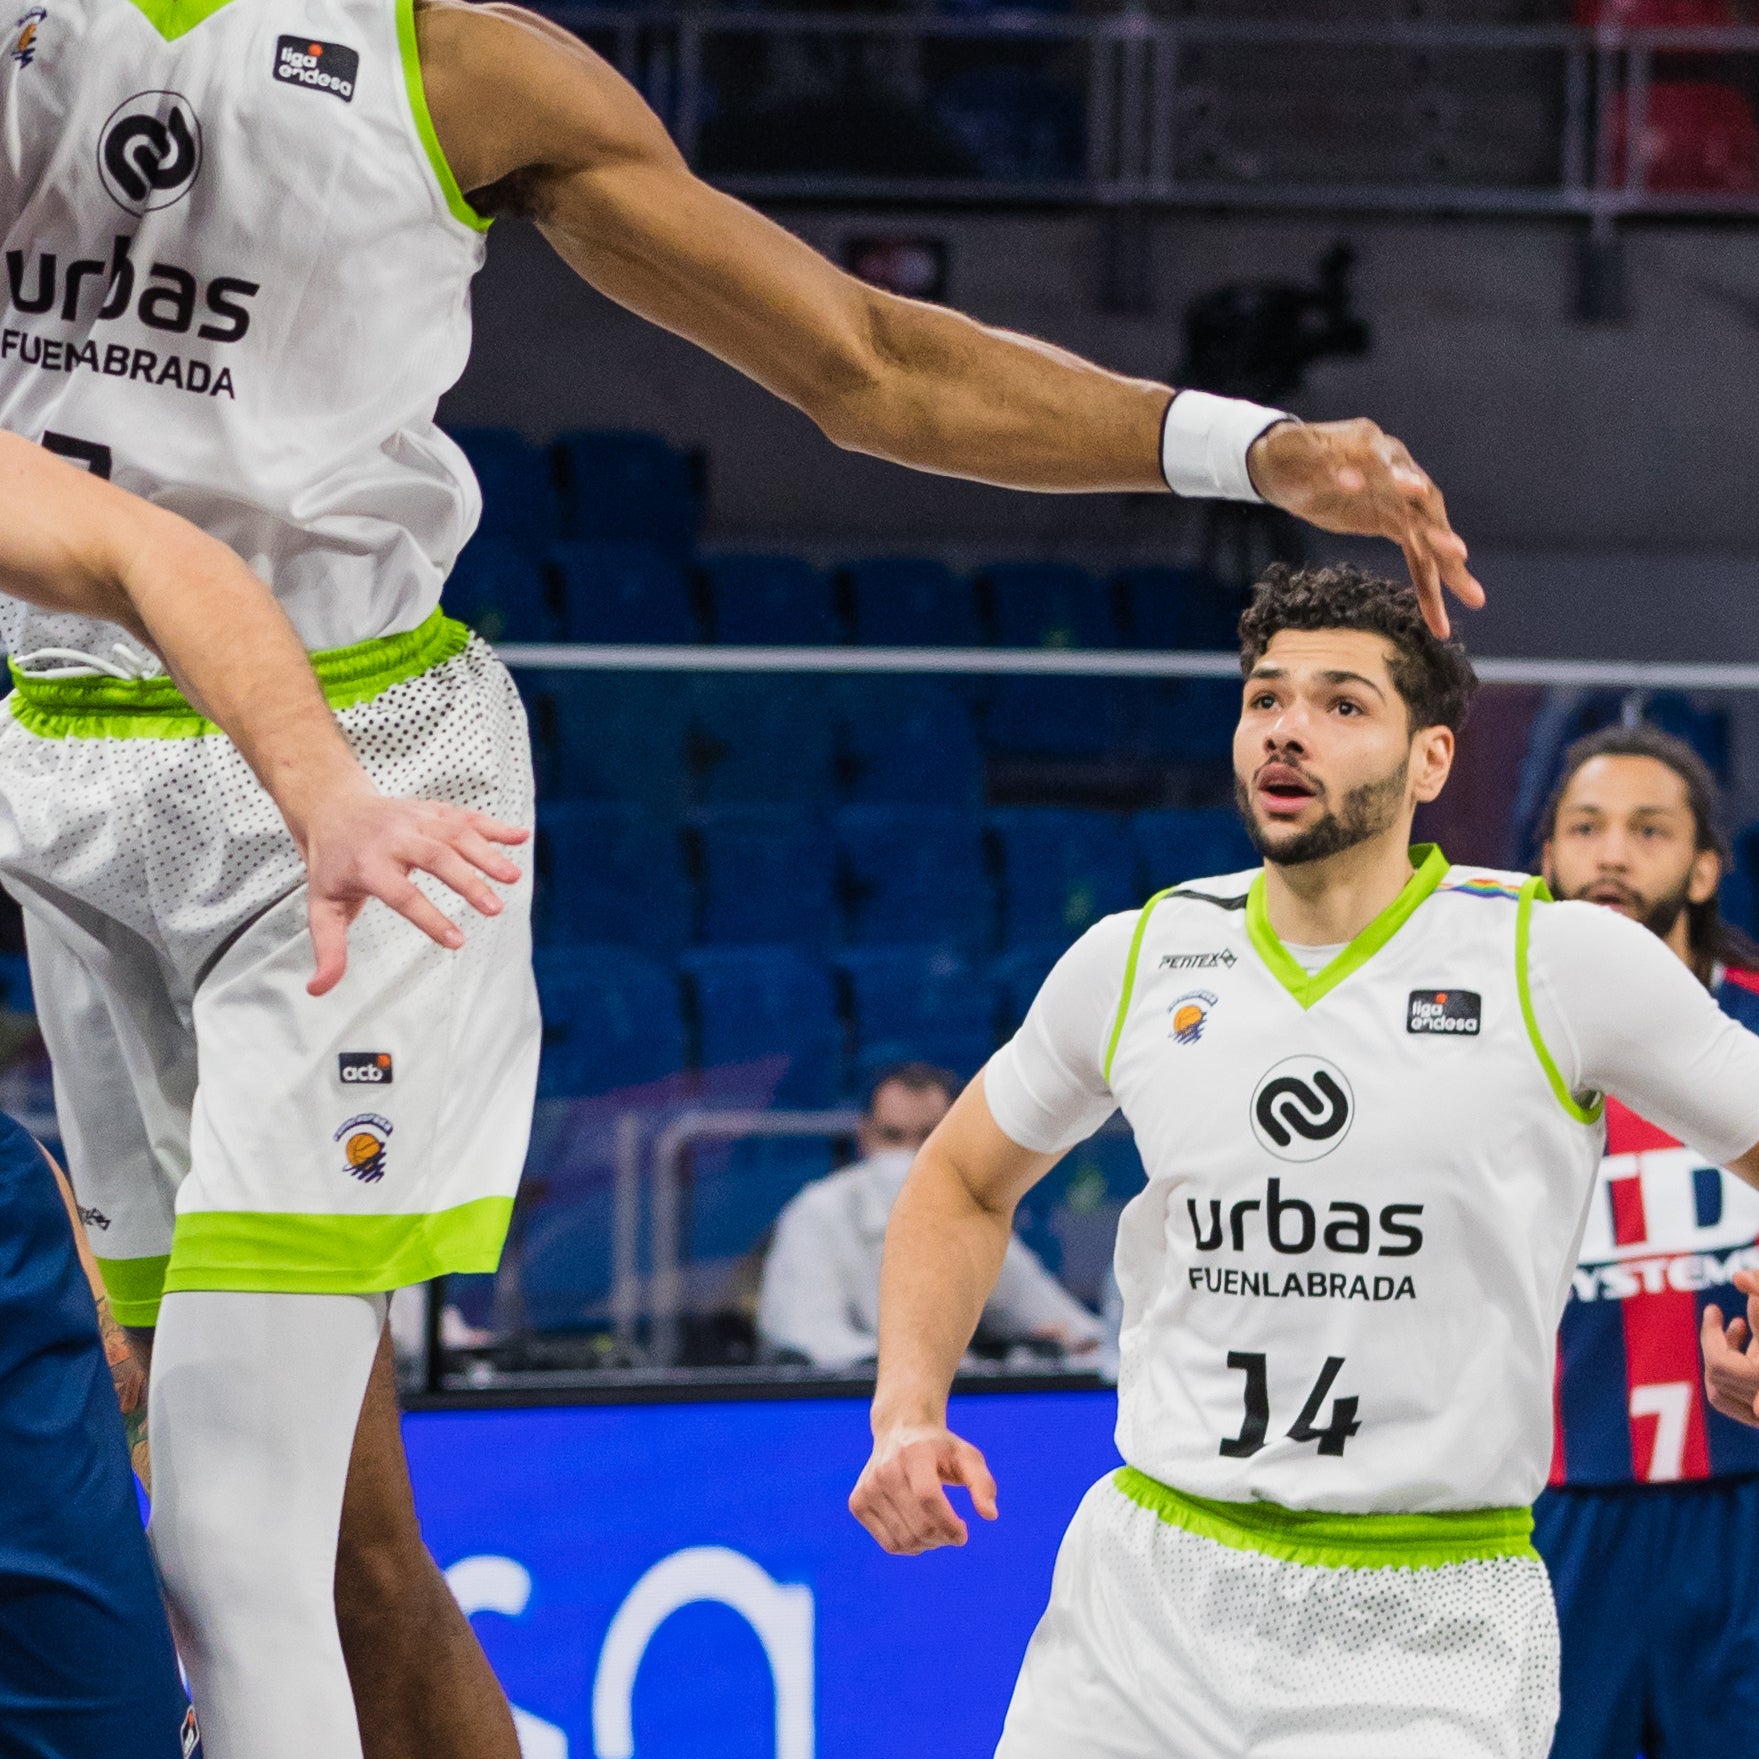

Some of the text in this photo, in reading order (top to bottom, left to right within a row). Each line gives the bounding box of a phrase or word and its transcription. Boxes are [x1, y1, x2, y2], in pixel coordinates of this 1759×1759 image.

[280, 46, 318, 69] liga
[278, 64, 352, 97] endesa
[6, 235, 261, 343] urbas
[1, 328, 236, 400] FUENABRADA
[1410, 1014, 1478, 1033] endesa
[1411, 999, 1444, 1018] liga
[342, 1063, 384, 1082] acb
[1186, 1177, 1425, 1257] urbas
[1188, 1267, 1417, 1302] FUENLABRADA
[1568, 1246, 1759, 1302] YSTEM
[1218, 1350, 1363, 1459] 14
[1629, 1380, 1694, 1483] 7
